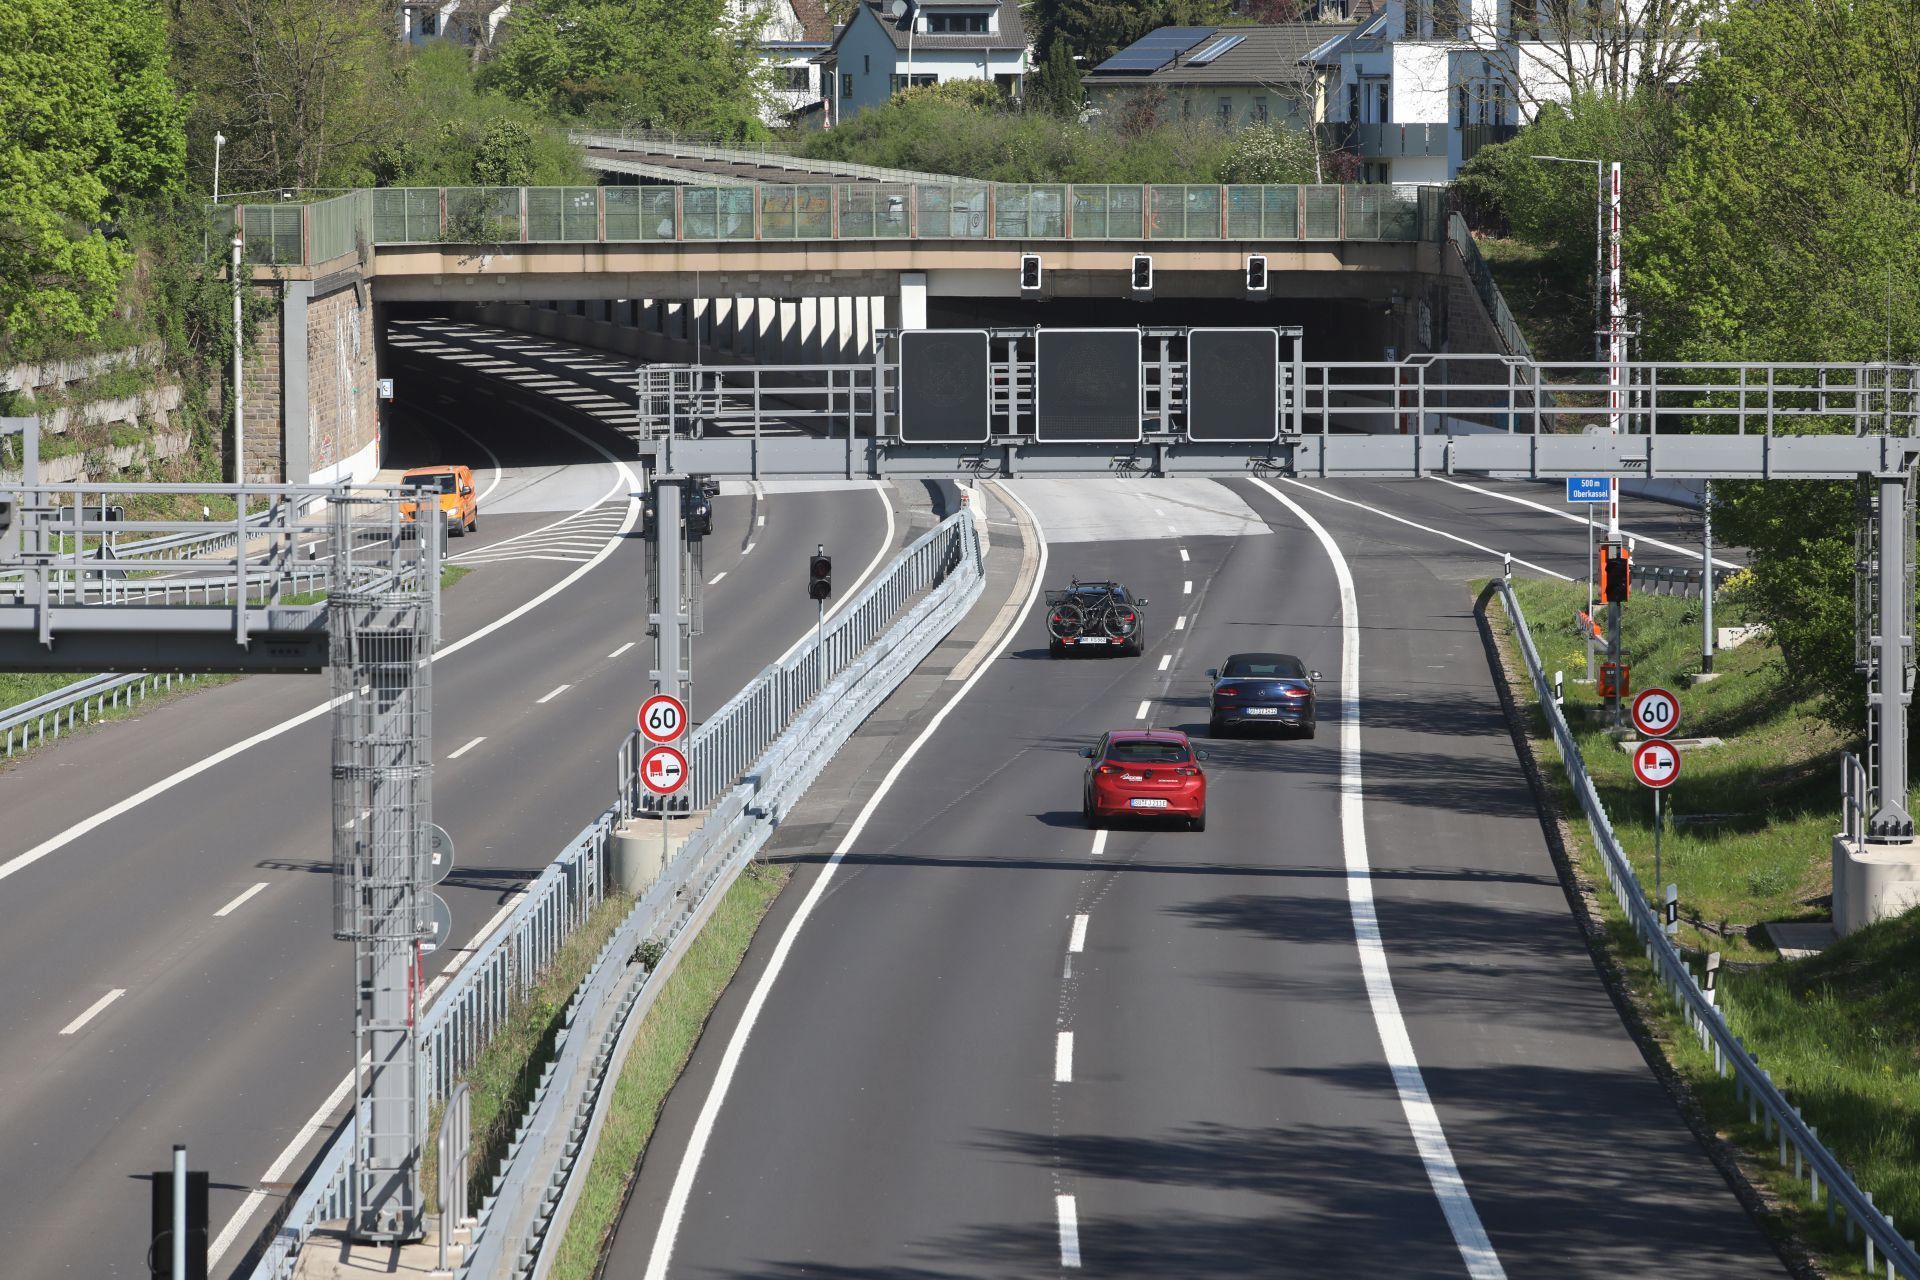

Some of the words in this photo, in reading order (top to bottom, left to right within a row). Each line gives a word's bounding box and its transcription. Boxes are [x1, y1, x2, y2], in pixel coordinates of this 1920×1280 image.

[1581, 479, 1593, 487] 500
[1573, 490, 1608, 498] Oberkassel
[649, 707, 675, 729] 60
[1642, 702, 1668, 722] 60
